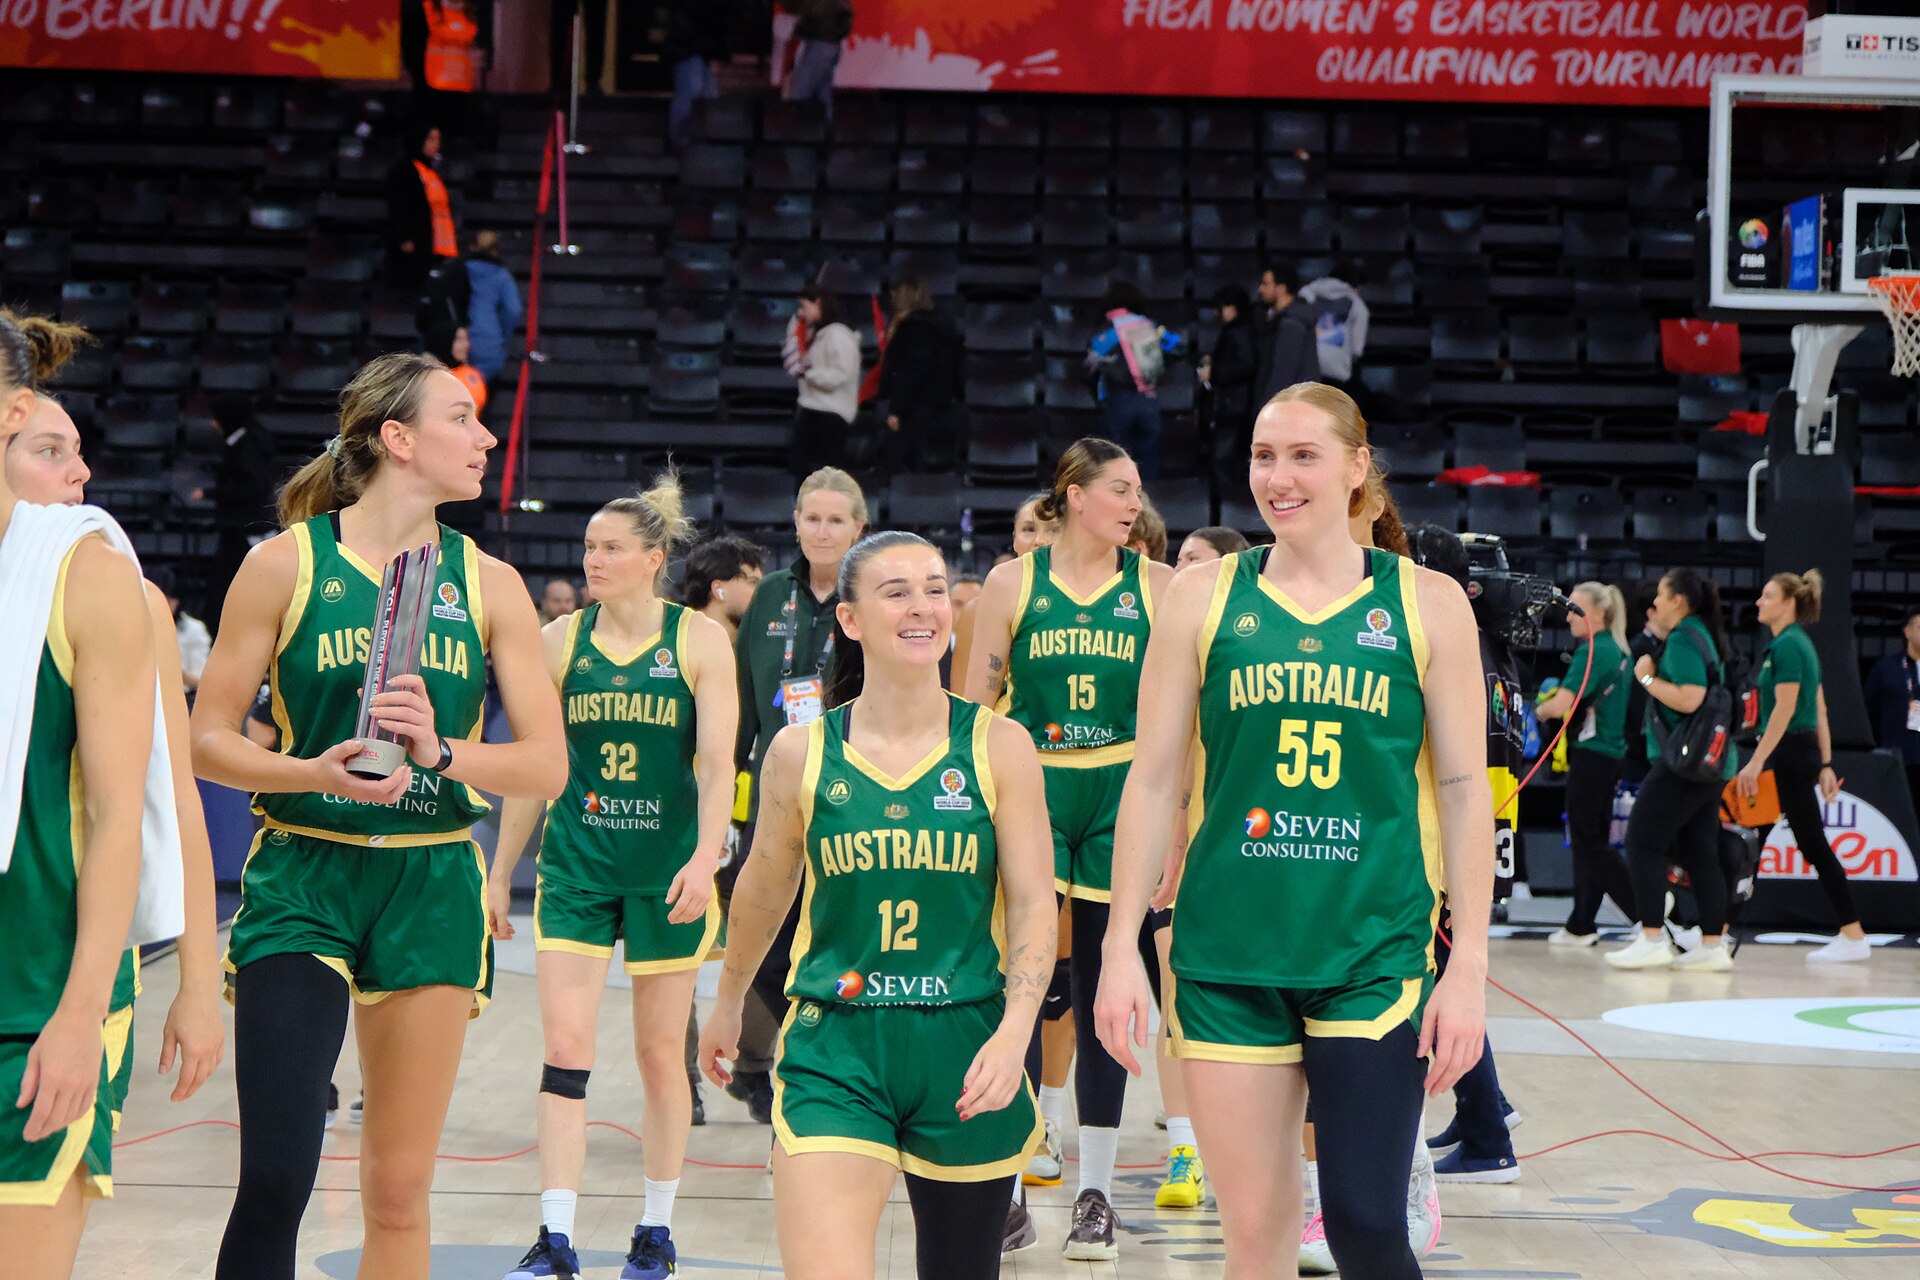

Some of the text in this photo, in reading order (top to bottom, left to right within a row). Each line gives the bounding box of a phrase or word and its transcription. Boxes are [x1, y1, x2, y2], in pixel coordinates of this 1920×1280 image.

[1123, 0, 1808, 40] FIBA WOMEN'S BASKETBALL WORLD
[1317, 47, 1538, 85] QUALIFYING
[385, 587, 395, 615] TCL
[317, 627, 468, 680] AUSLIA
[1029, 628, 1135, 663] AUSTRALIA
[1067, 674, 1096, 711] 15
[1229, 661, 1391, 718] AUSTRALIA
[568, 692, 677, 727] AUSTRALIA
[1063, 723, 1113, 742] SEVEN
[600, 742, 637, 782] 32
[1276, 719, 1342, 790] 55
[582, 813, 660, 830] CONSULTING
[599, 795, 660, 815] SEVEN
[1273, 811, 1362, 841] SEVEN
[820, 829, 978, 877] AUSTRALIA
[1240, 841, 1360, 862] CONSULTING
[878, 899, 919, 953] 12
[866, 971, 950, 997] SEVEN
